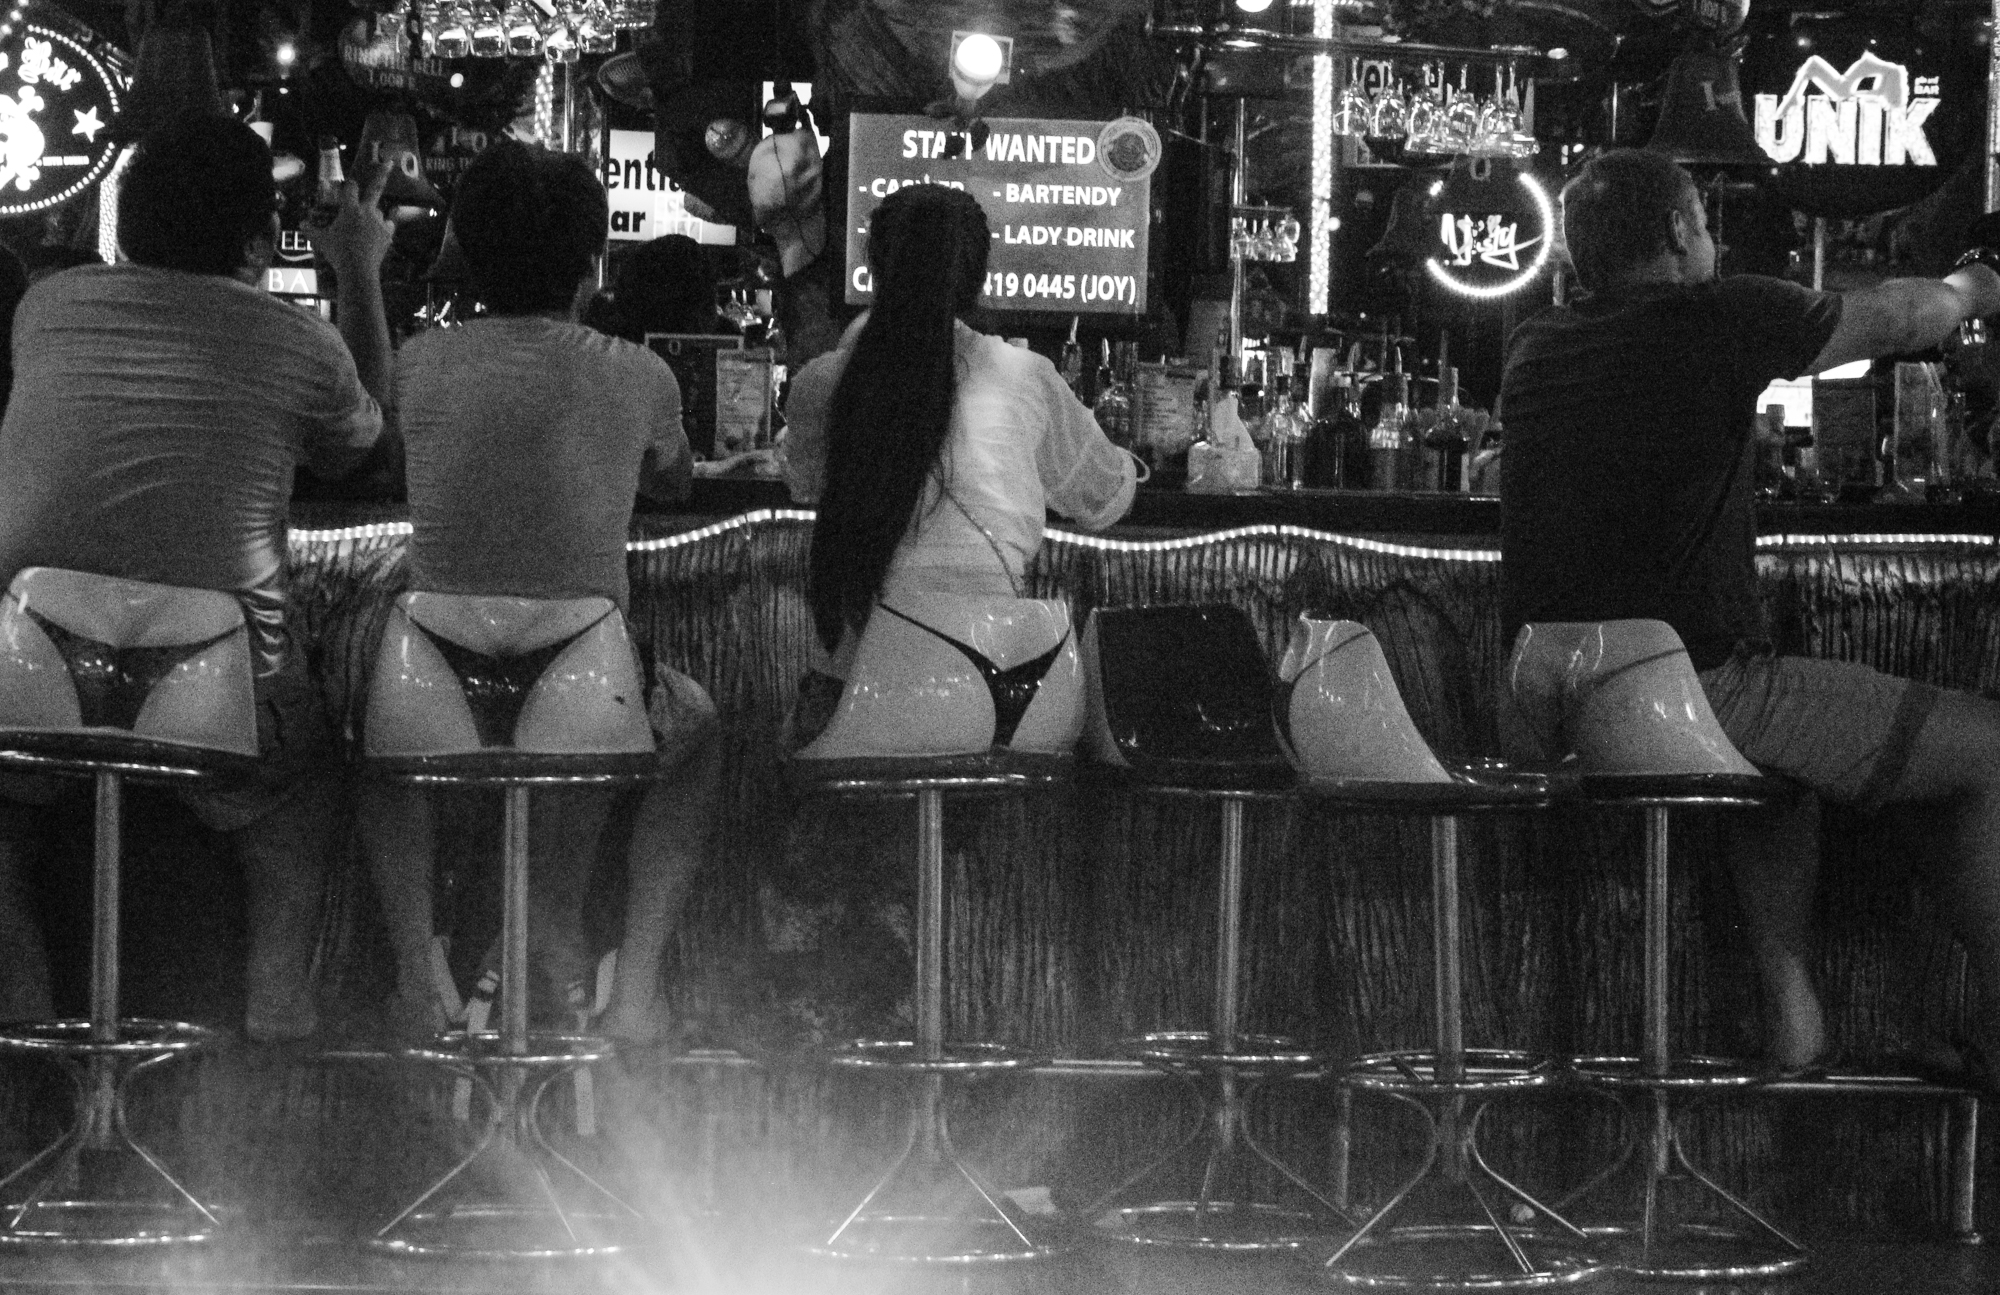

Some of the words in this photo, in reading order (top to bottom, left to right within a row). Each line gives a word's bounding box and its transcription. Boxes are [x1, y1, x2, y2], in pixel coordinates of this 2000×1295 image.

[1914, 84, 1940, 95] BAR
[1755, 93, 1942, 167] UNIK
[902, 130, 974, 161] STA
[986, 134, 1096, 165] WANTED
[1005, 183, 1122, 206] BARTENDY
[1004, 224, 1062, 246] LADY
[1066, 226, 1135, 248] DRINK
[1023, 273, 1076, 299] 0445
[1080, 274, 1137, 304] (JOY)
